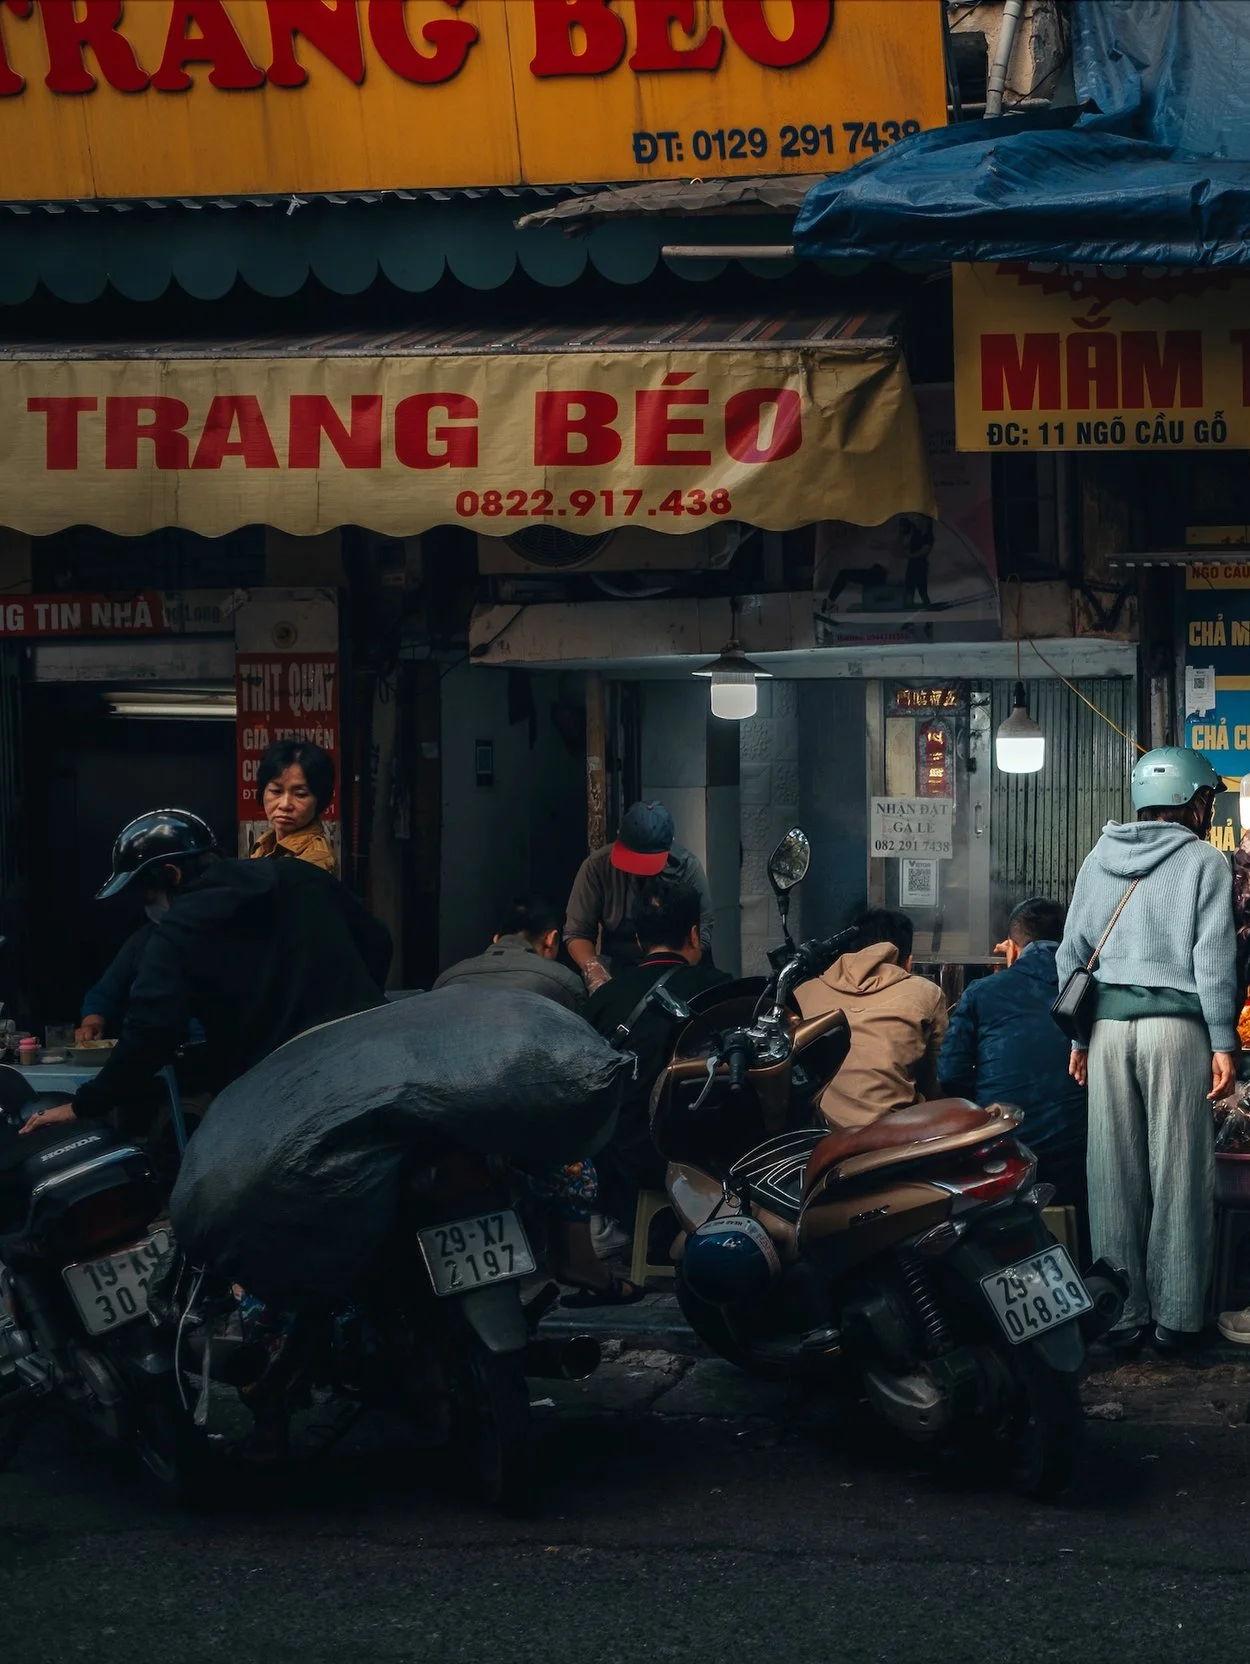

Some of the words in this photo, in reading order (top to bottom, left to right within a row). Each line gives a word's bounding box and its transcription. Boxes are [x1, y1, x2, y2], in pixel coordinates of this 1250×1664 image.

[0, 0, 479, 95] RANG
[633, 131, 684, 164] ĐT:
[692, 128, 769, 161] 0129
[780, 124, 834, 158] 291
[981, 302, 1203, 411] MẮM
[27, 392, 479, 470] TRANG
[534, 372, 802, 467] BÉO
[986, 422, 1029, 446] ĐC:
[1038, 421, 1065, 445] 11
[1077, 416, 1126, 445] NGÕ
[1136, 411, 1185, 444] CẦU
[1194, 410, 1228, 444] GỖ
[456, 488, 732, 517] 0822.917.438
[0, 603, 25, 631] G
[32, 603, 82, 630] TIN
[91, 595, 154, 629] NHÀ
[1188, 613, 1227, 647] CHẢ
[238, 663, 283, 722] THỊT
[288, 662, 337, 717] QUAY
[1191, 717, 1230, 751] CHẢ
[875, 840, 895, 851] 082
[899, 840, 918, 851] 291
[1206, 818, 1236, 852] HẢ
[41, 1135, 102, 1162] HONDA
[444, 1244, 514, 1287] 2197
[1005, 1281, 1086, 1337] 048.99
